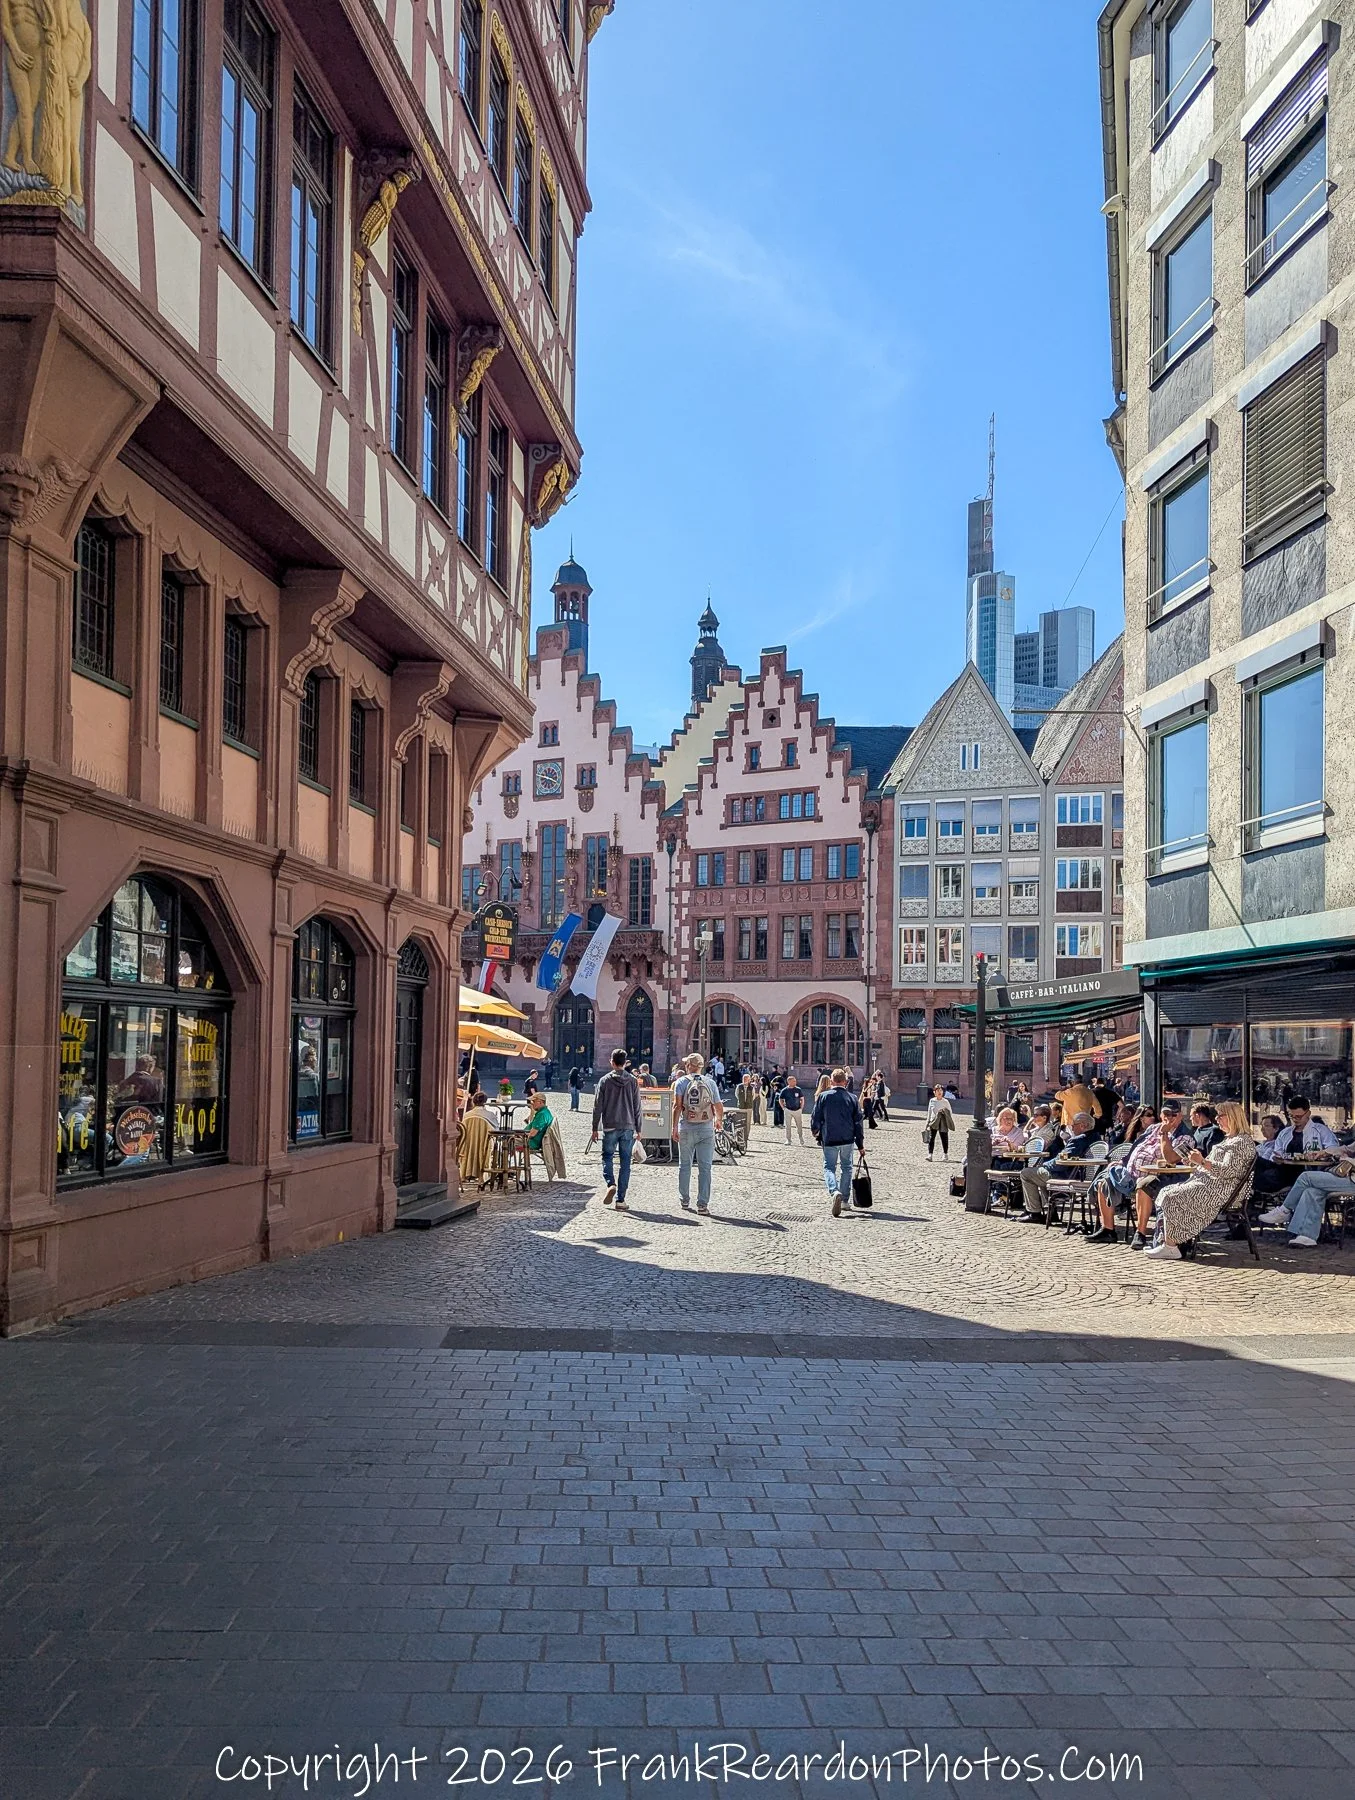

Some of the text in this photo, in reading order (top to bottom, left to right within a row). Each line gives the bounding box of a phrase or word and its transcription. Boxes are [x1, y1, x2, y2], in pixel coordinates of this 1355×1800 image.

[1038, 987, 1054, 997] BAR
[1059, 980, 1101, 995] ITALIANO
[301, 1114, 319, 1128] ATM
